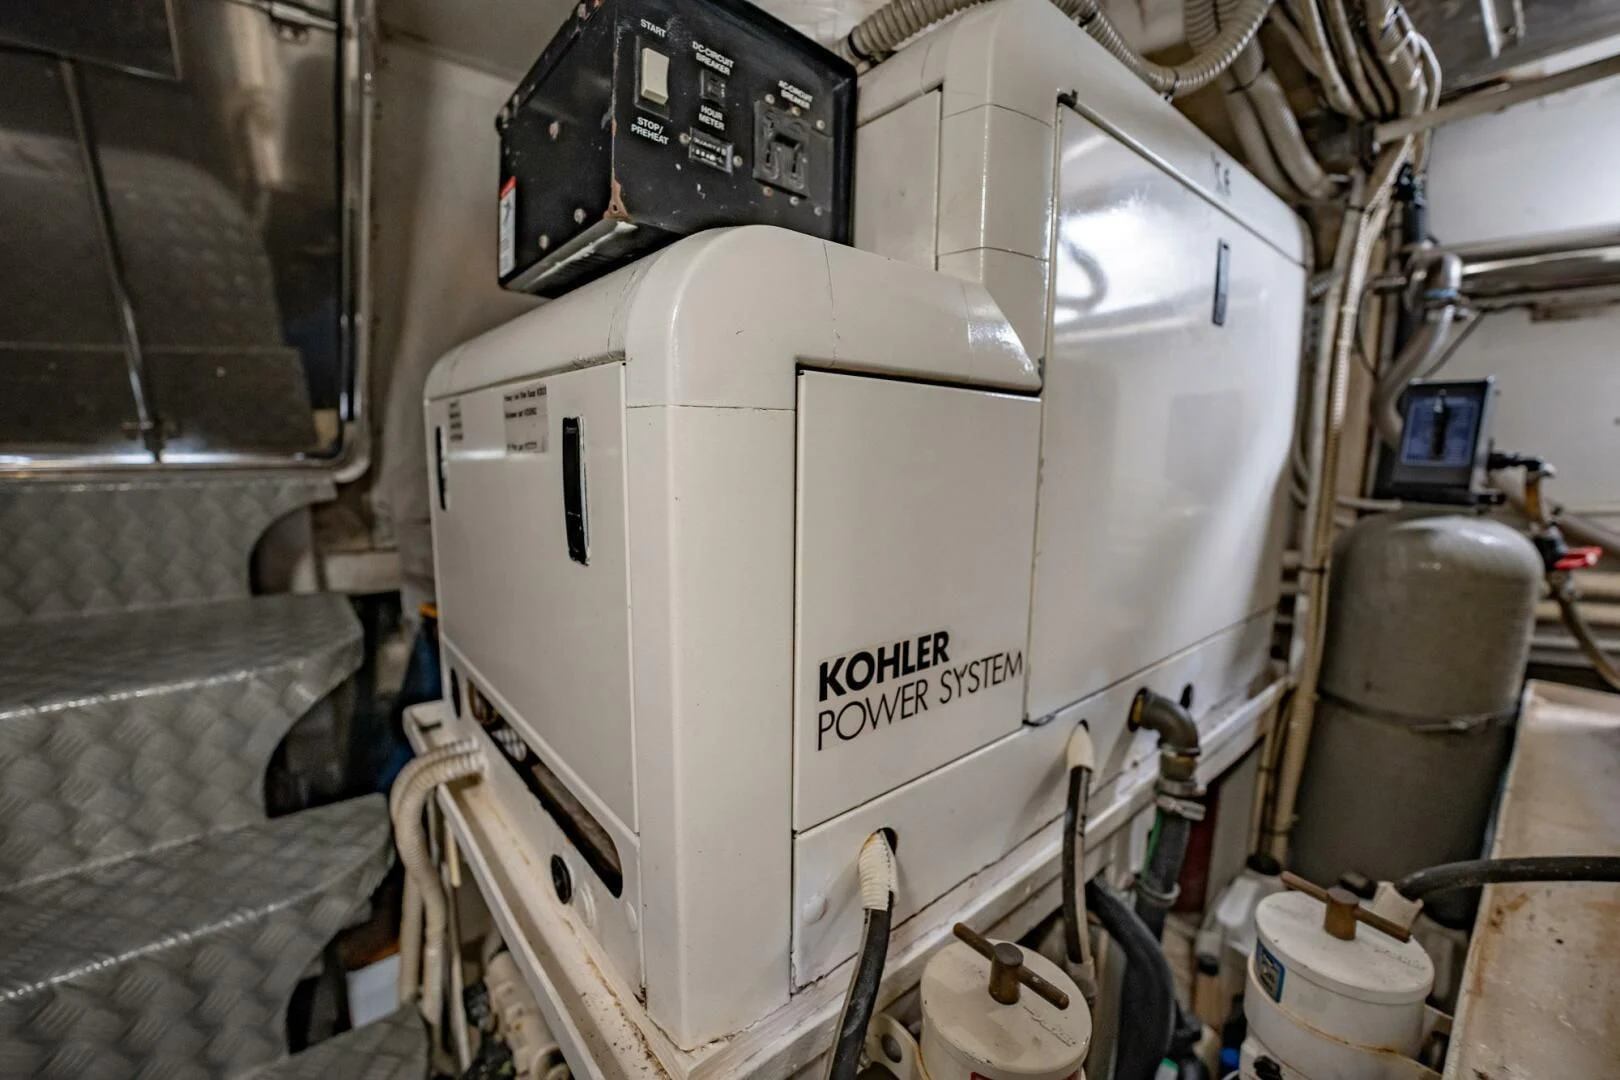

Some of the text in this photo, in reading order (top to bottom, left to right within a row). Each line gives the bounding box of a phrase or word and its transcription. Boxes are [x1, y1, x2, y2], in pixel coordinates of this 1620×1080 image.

[640, 18, 666, 37] START
[696, 52, 730, 75] BREAKER
[699, 113, 725, 131] METER
[701, 105, 723, 120] HOUR
[631, 124, 669, 145] PREHEAT
[637, 117, 664, 134] STOP/
[819, 631, 950, 702] KOHLER
[818, 650, 1024, 751] POWER SYSTEM
